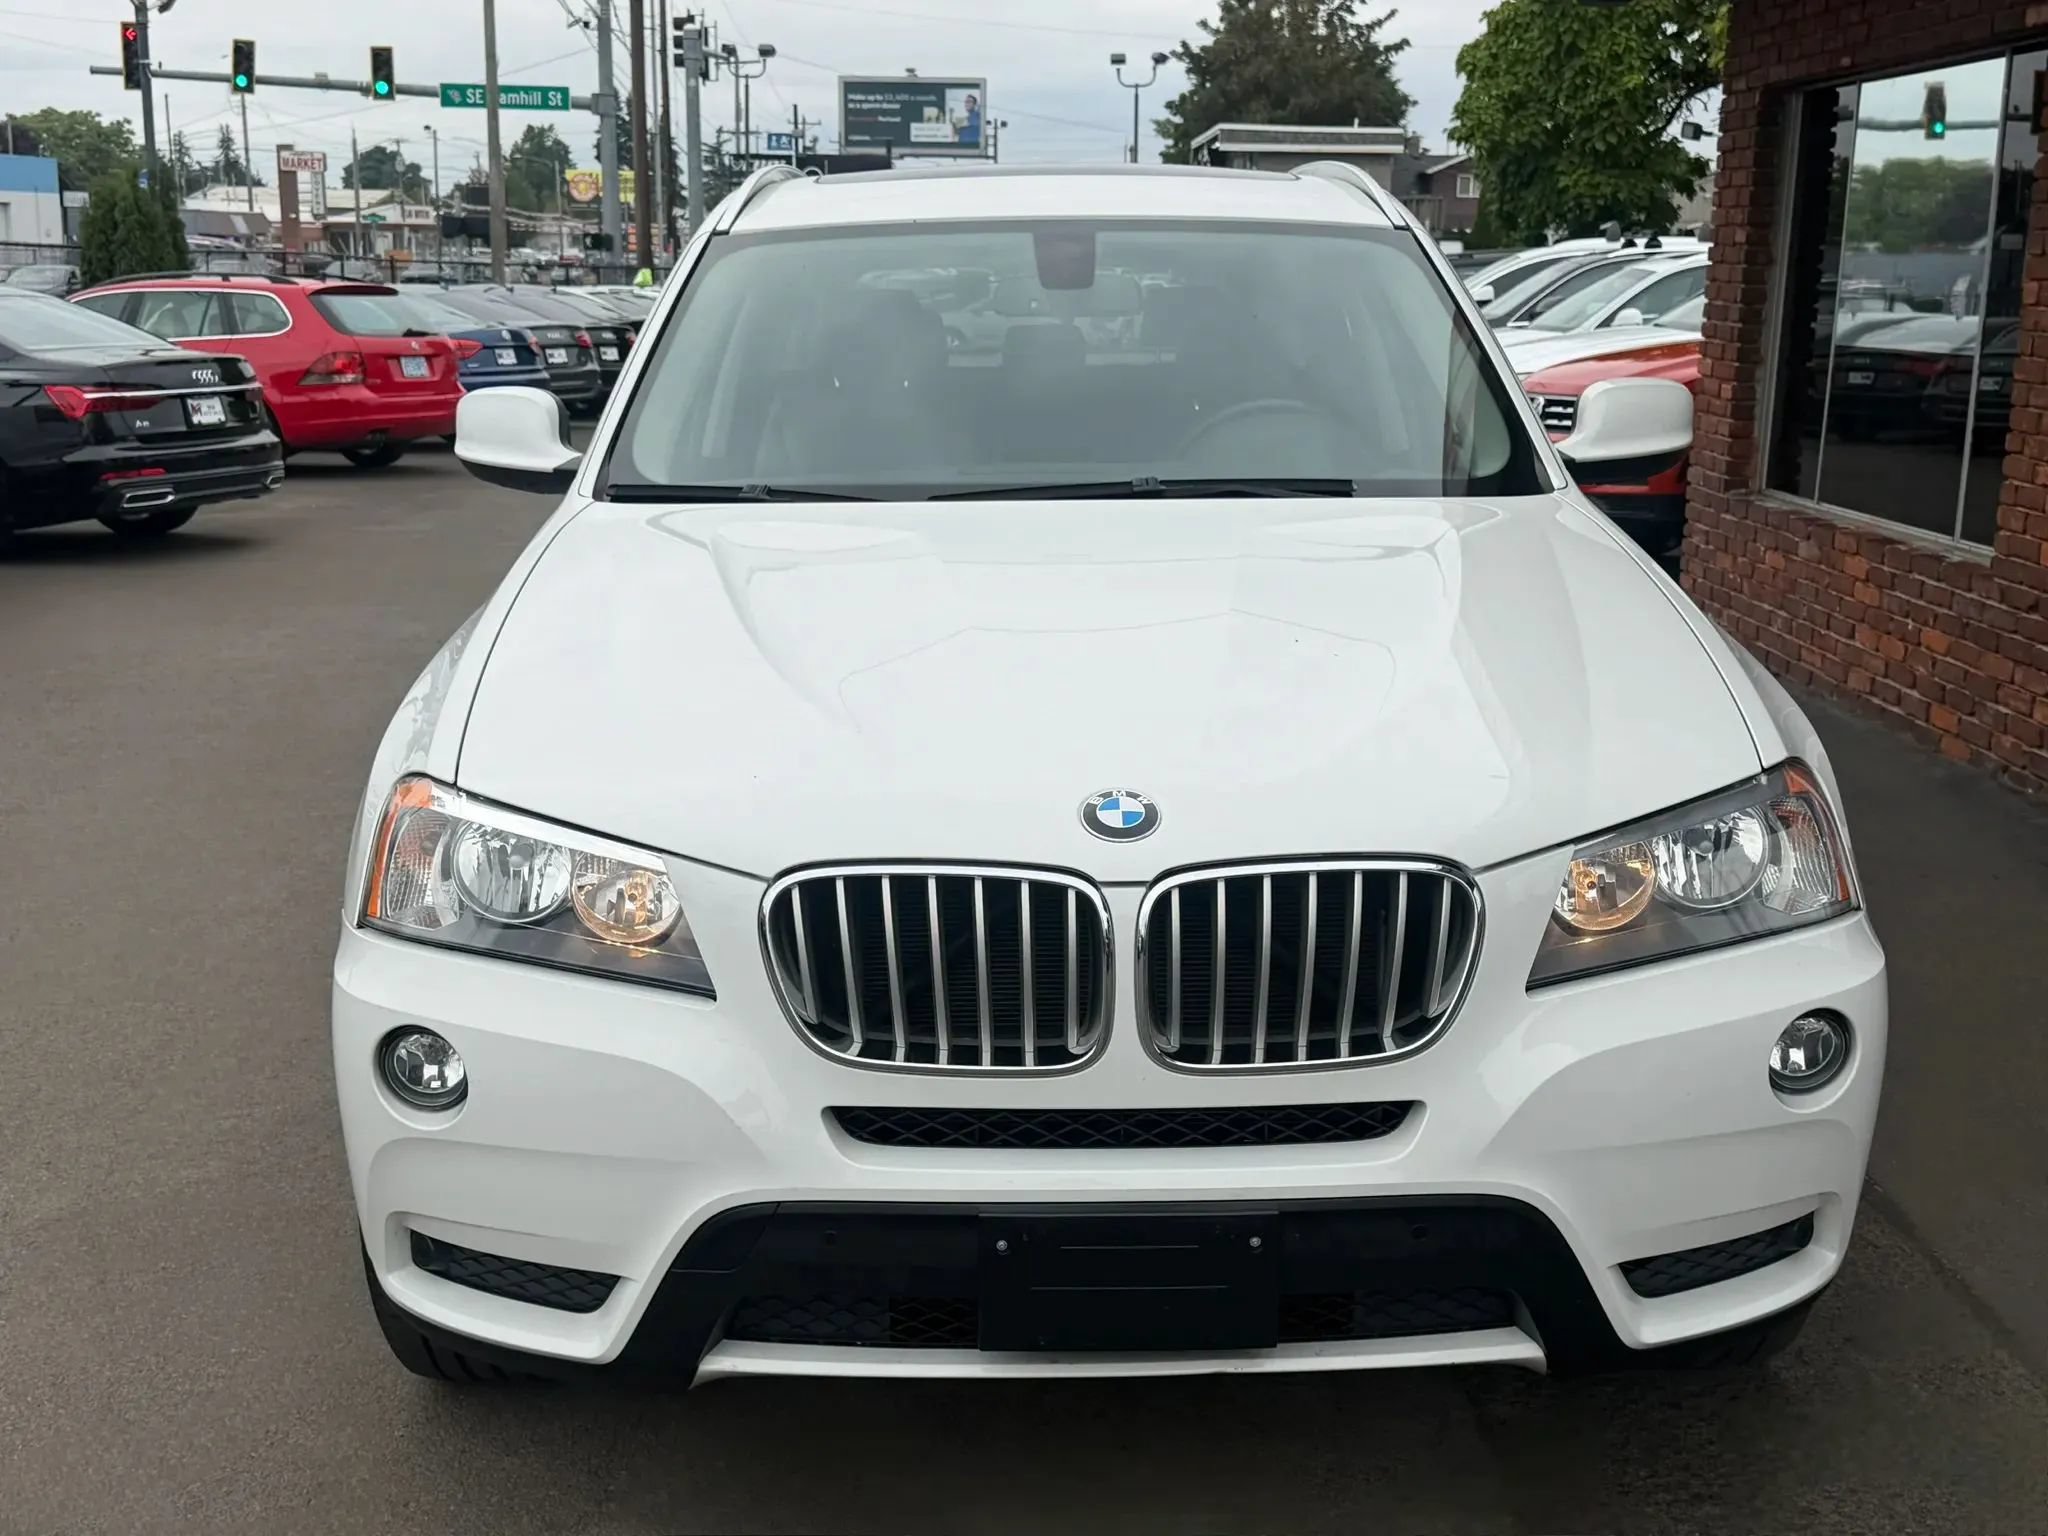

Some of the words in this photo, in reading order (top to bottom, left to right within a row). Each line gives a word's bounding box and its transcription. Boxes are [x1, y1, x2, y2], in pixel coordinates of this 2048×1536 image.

[466, 88, 484, 104] SE
[498, 89, 542, 106] amhill
[548, 91, 563, 106] St
[282, 157, 322, 171] MARKET
[1088, 790, 1154, 805] BMW
